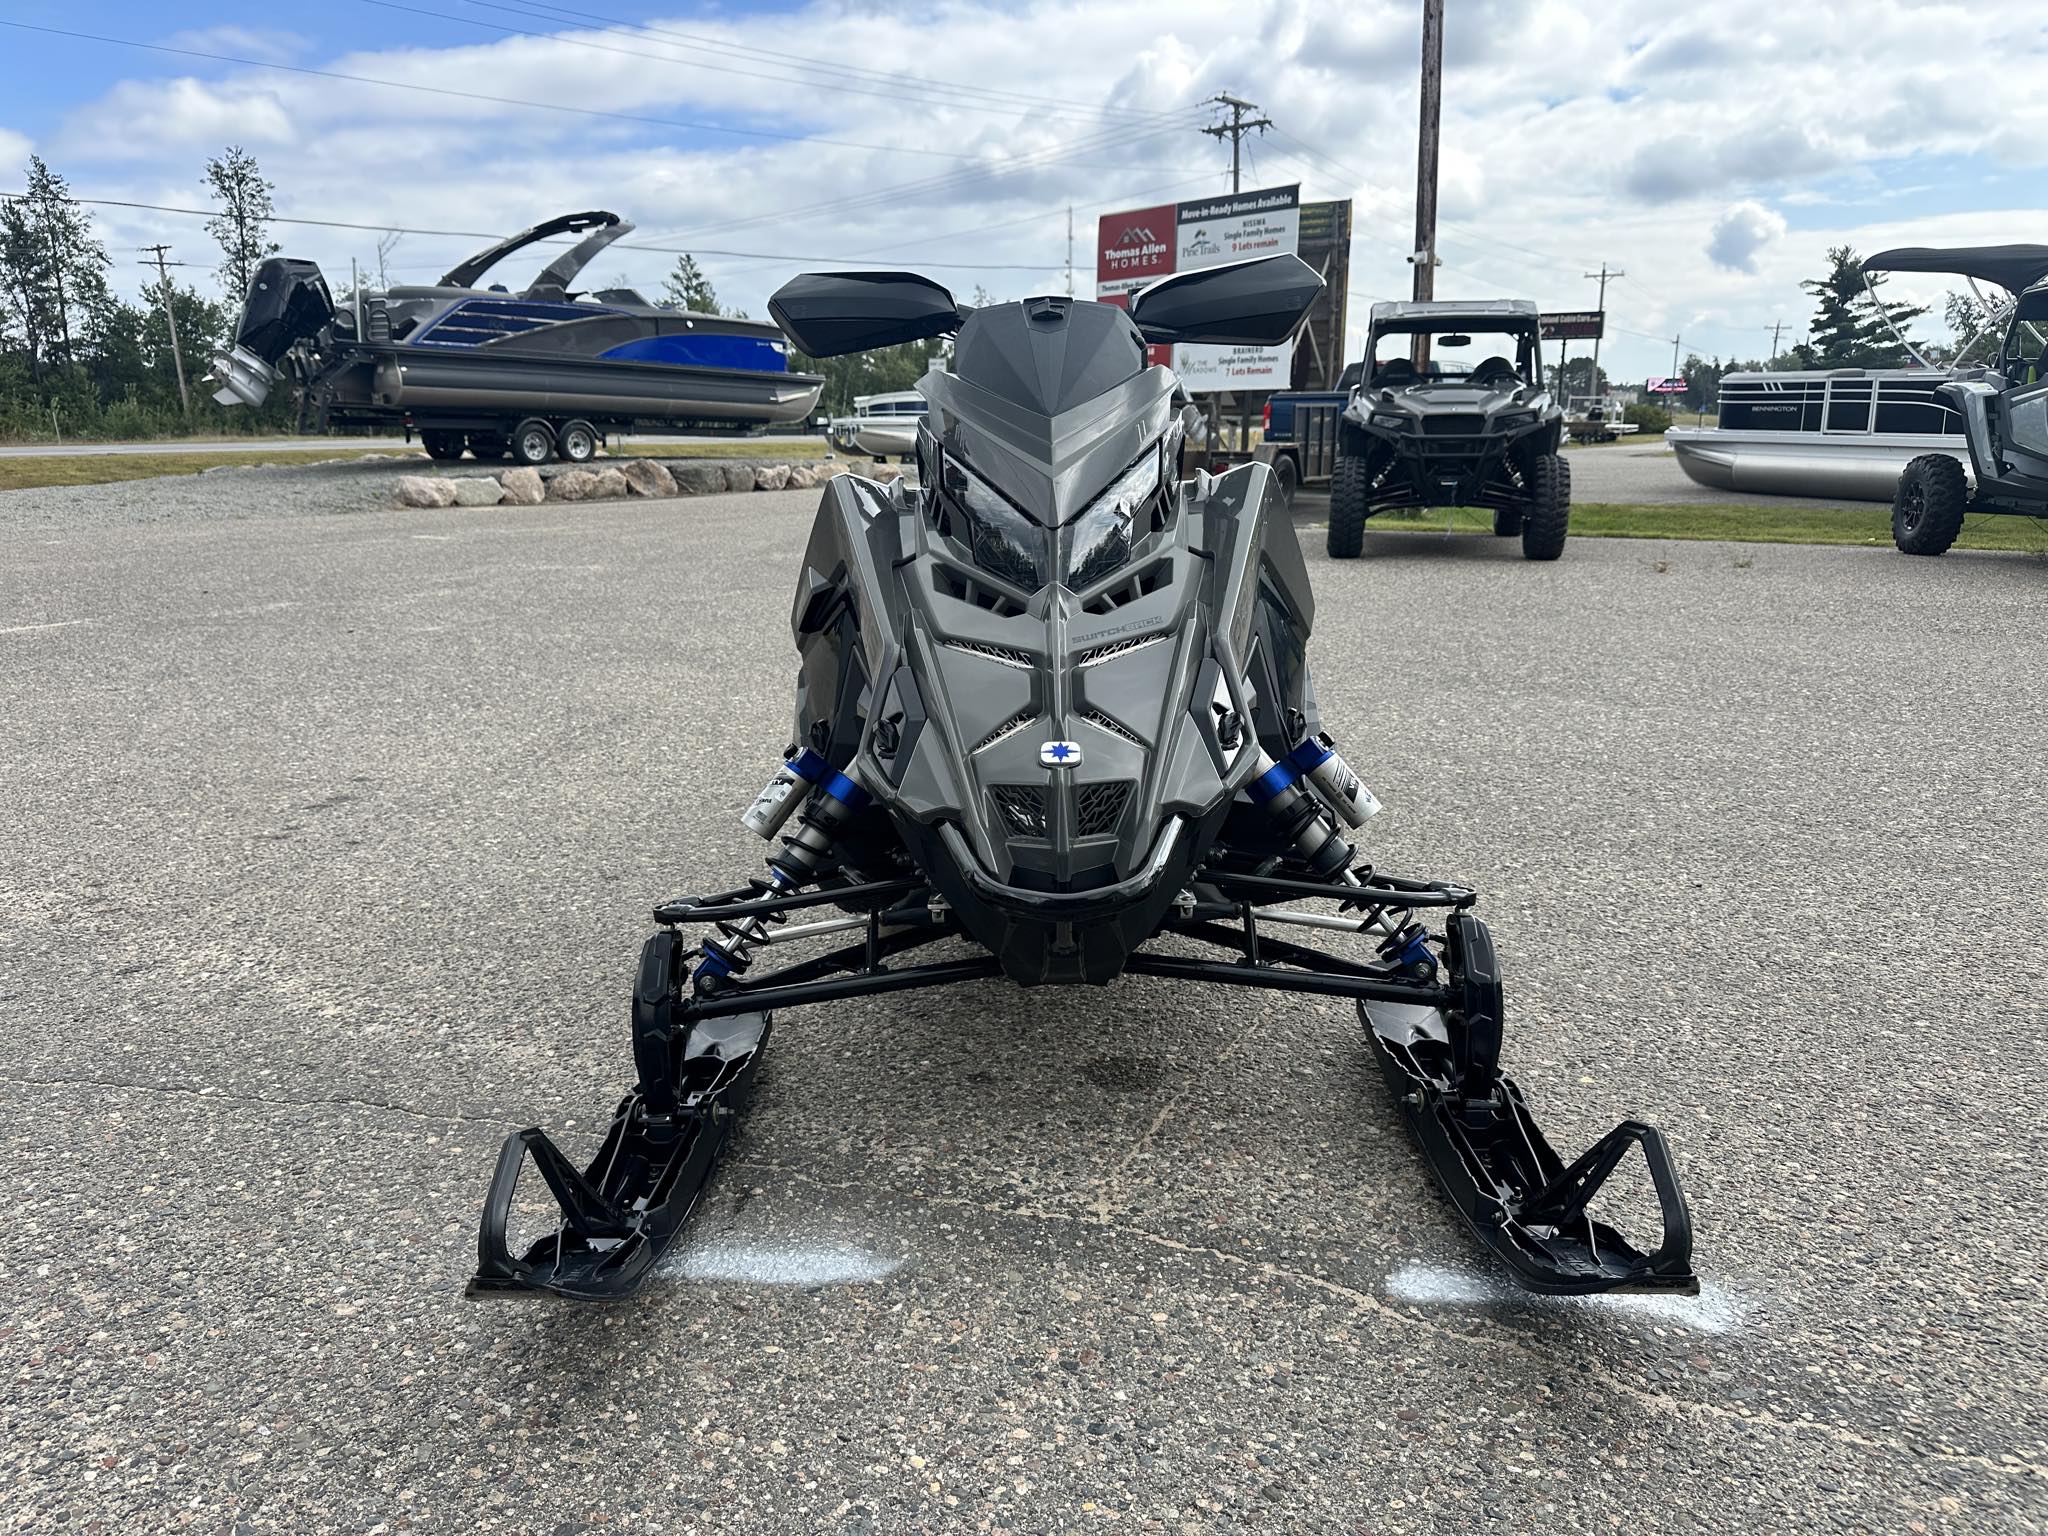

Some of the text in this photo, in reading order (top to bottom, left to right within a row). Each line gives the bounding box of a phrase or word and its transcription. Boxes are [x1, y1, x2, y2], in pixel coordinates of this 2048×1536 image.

[1181, 194, 1292, 219] Move-in-Ready Homes Available
[1224, 229, 1242, 240] Single
[1243, 227, 1264, 238] Family
[1264, 226, 1286, 234] Homes
[1104, 243, 1167, 260] Thomas Allen
[1199, 244, 1220, 255] Trails
[1232, 239, 1279, 252] 9 Lots remain
[1111, 254, 1158, 270] HOMES
[1218, 356, 1236, 366] Single
[1237, 355, 1258, 365] Family
[1231, 367, 1246, 376] Lots
[1247, 366, 1273, 375] Remain
[1072, 616, 1163, 643] SWITCHBACK
